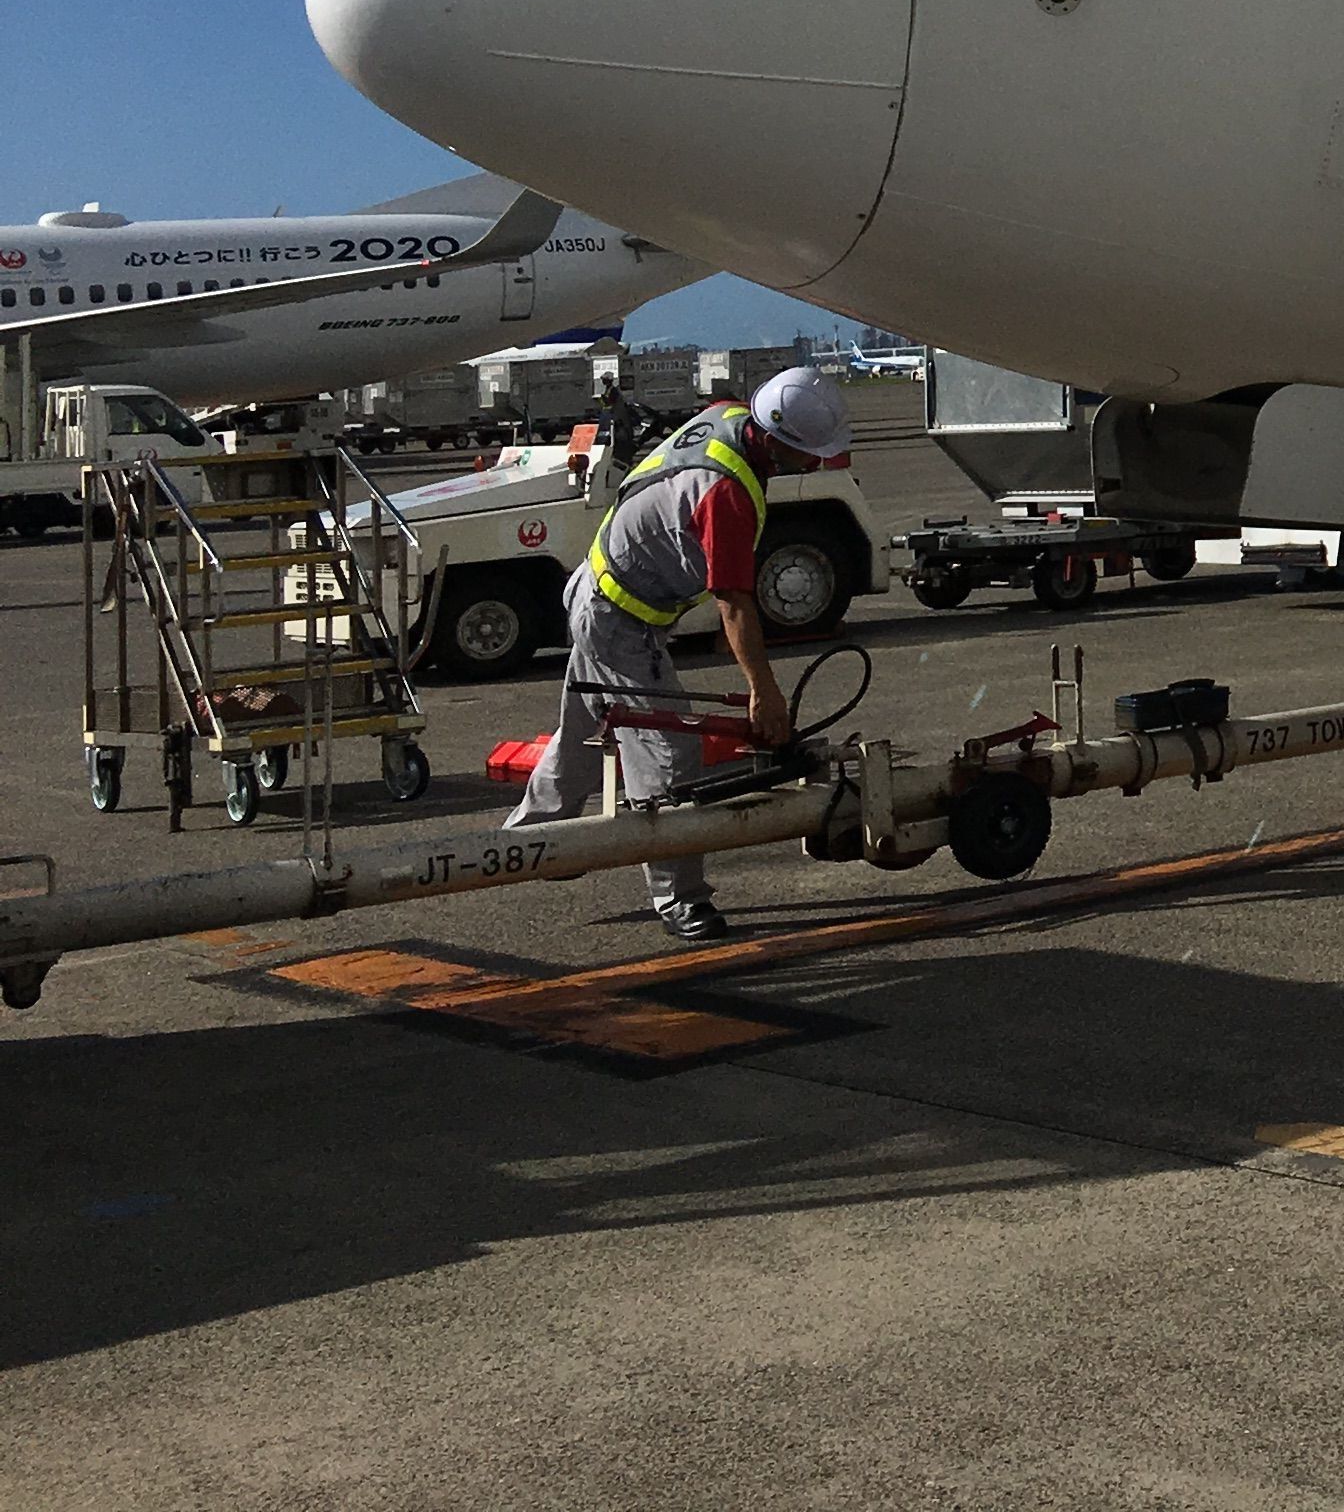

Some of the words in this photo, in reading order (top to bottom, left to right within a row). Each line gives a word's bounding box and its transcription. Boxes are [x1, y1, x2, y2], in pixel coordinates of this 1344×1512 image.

[329, 235, 460, 263] 2020
[545, 237, 606, 253] JA350J
[318, 318, 384, 331] BOEING
[386, 314, 462, 327] 737-800
[1246, 725, 1290, 755] 737
